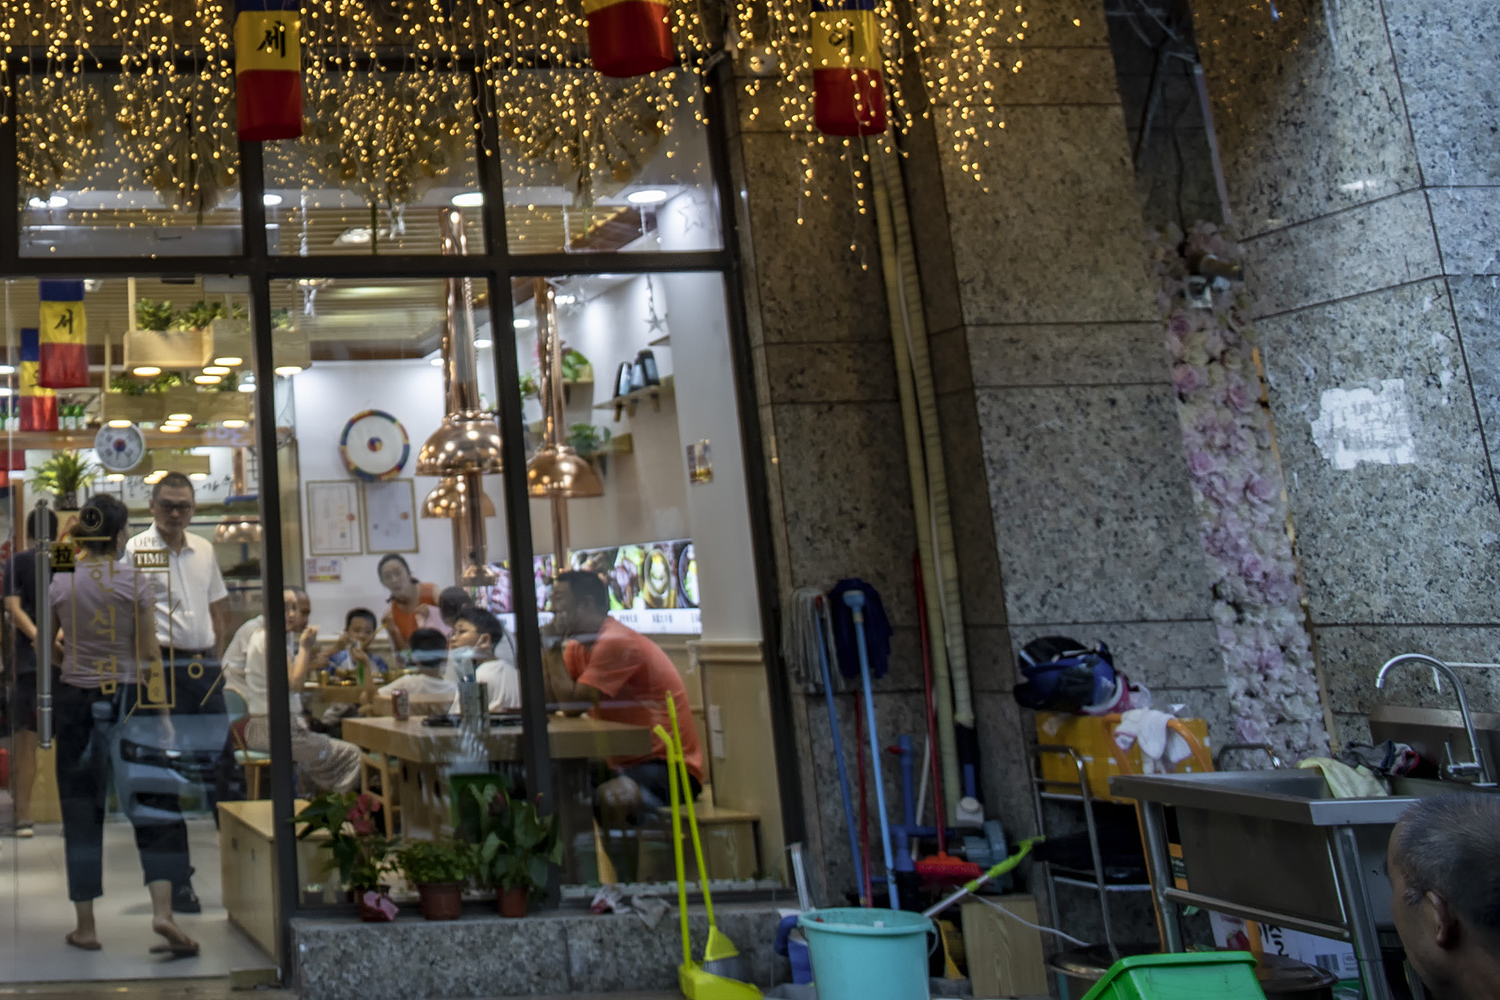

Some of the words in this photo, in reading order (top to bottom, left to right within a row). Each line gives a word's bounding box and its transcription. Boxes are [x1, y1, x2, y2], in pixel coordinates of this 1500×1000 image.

[256, 20, 286, 59] 세
[54, 546, 74, 567] 拉
[135, 553, 167, 565] TIME
